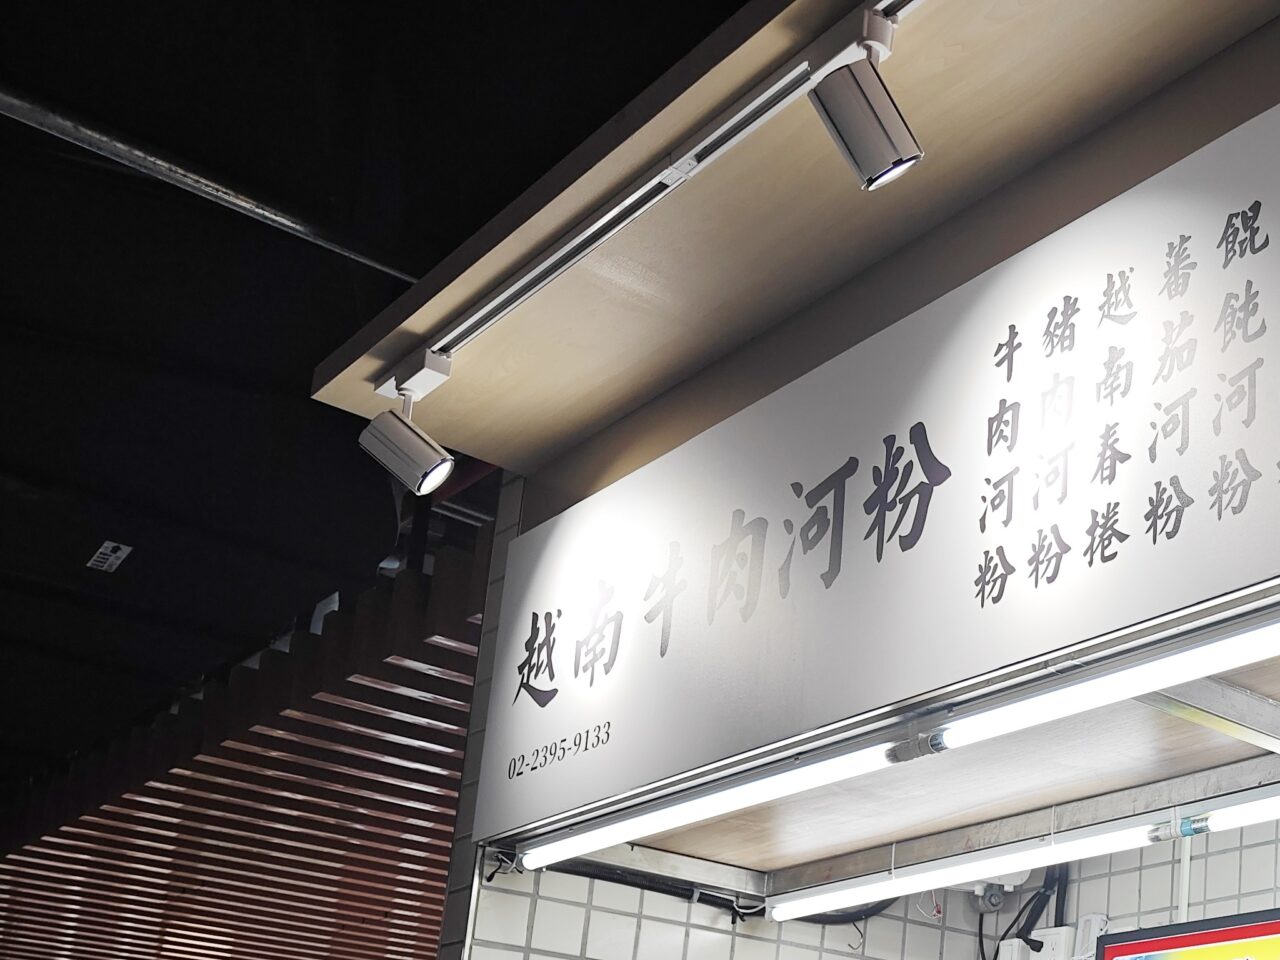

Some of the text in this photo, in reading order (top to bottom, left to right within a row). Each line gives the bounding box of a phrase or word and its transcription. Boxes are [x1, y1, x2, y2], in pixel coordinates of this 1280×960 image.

[975, 325, 1022, 608] 牛肉河粉
[1027, 296, 1080, 589] 豬肉河粉
[1083, 267, 1137, 567] 越南春捲
[1144, 235, 1198, 545] 蕃茄河粉
[1209, 201, 1269, 520] 餛飩河粉
[511, 421, 951, 708] 越南牛肉河粉
[508, 722, 612, 780] 02-2395-9133
